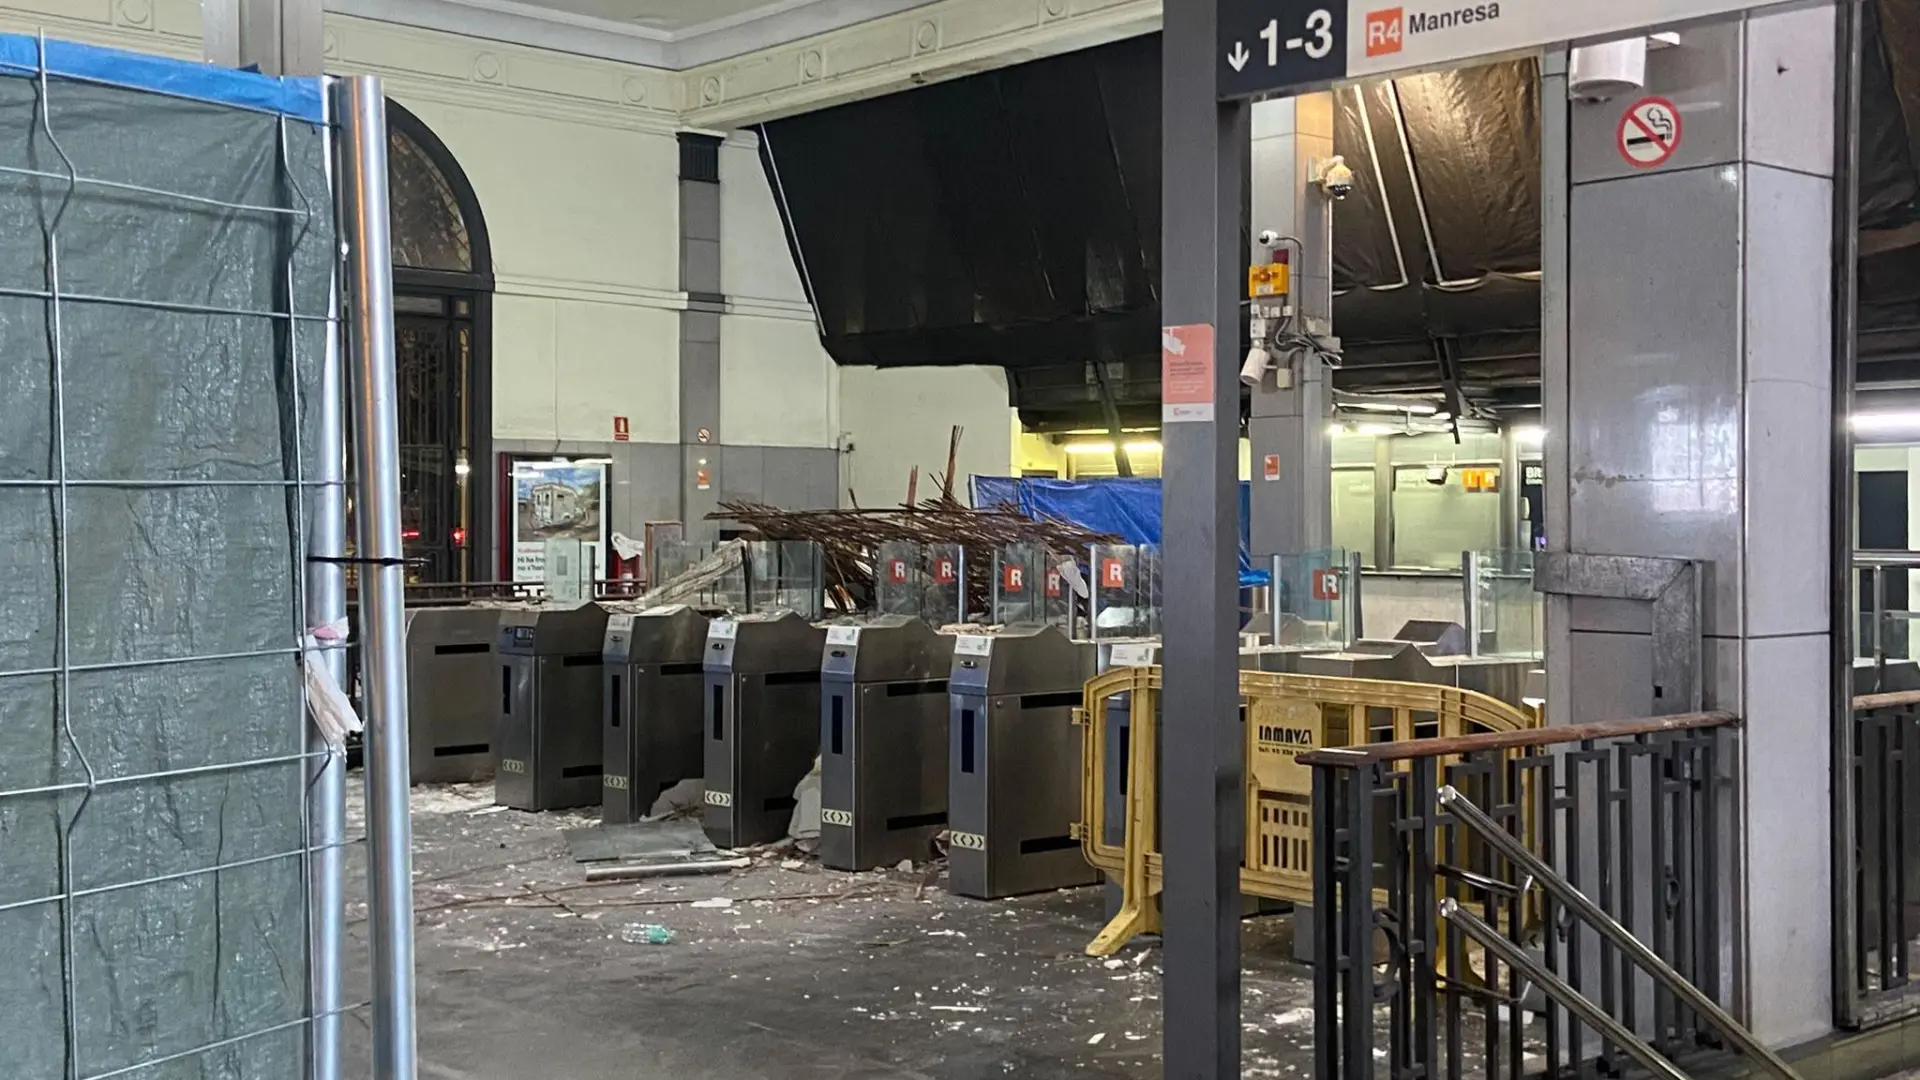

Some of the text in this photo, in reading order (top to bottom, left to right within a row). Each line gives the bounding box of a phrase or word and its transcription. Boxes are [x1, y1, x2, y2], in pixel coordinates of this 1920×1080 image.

[1367, 2, 1501, 48] R4 Manresa
[1259, 9, 1333, 67] 1-3
[895, 561, 905, 578] R
[941, 561, 952, 578] R
[1010, 569, 1022, 586] R
[1110, 563, 1123, 581] R
[1048, 573, 1060, 590] R
[1322, 574, 1337, 593] R
